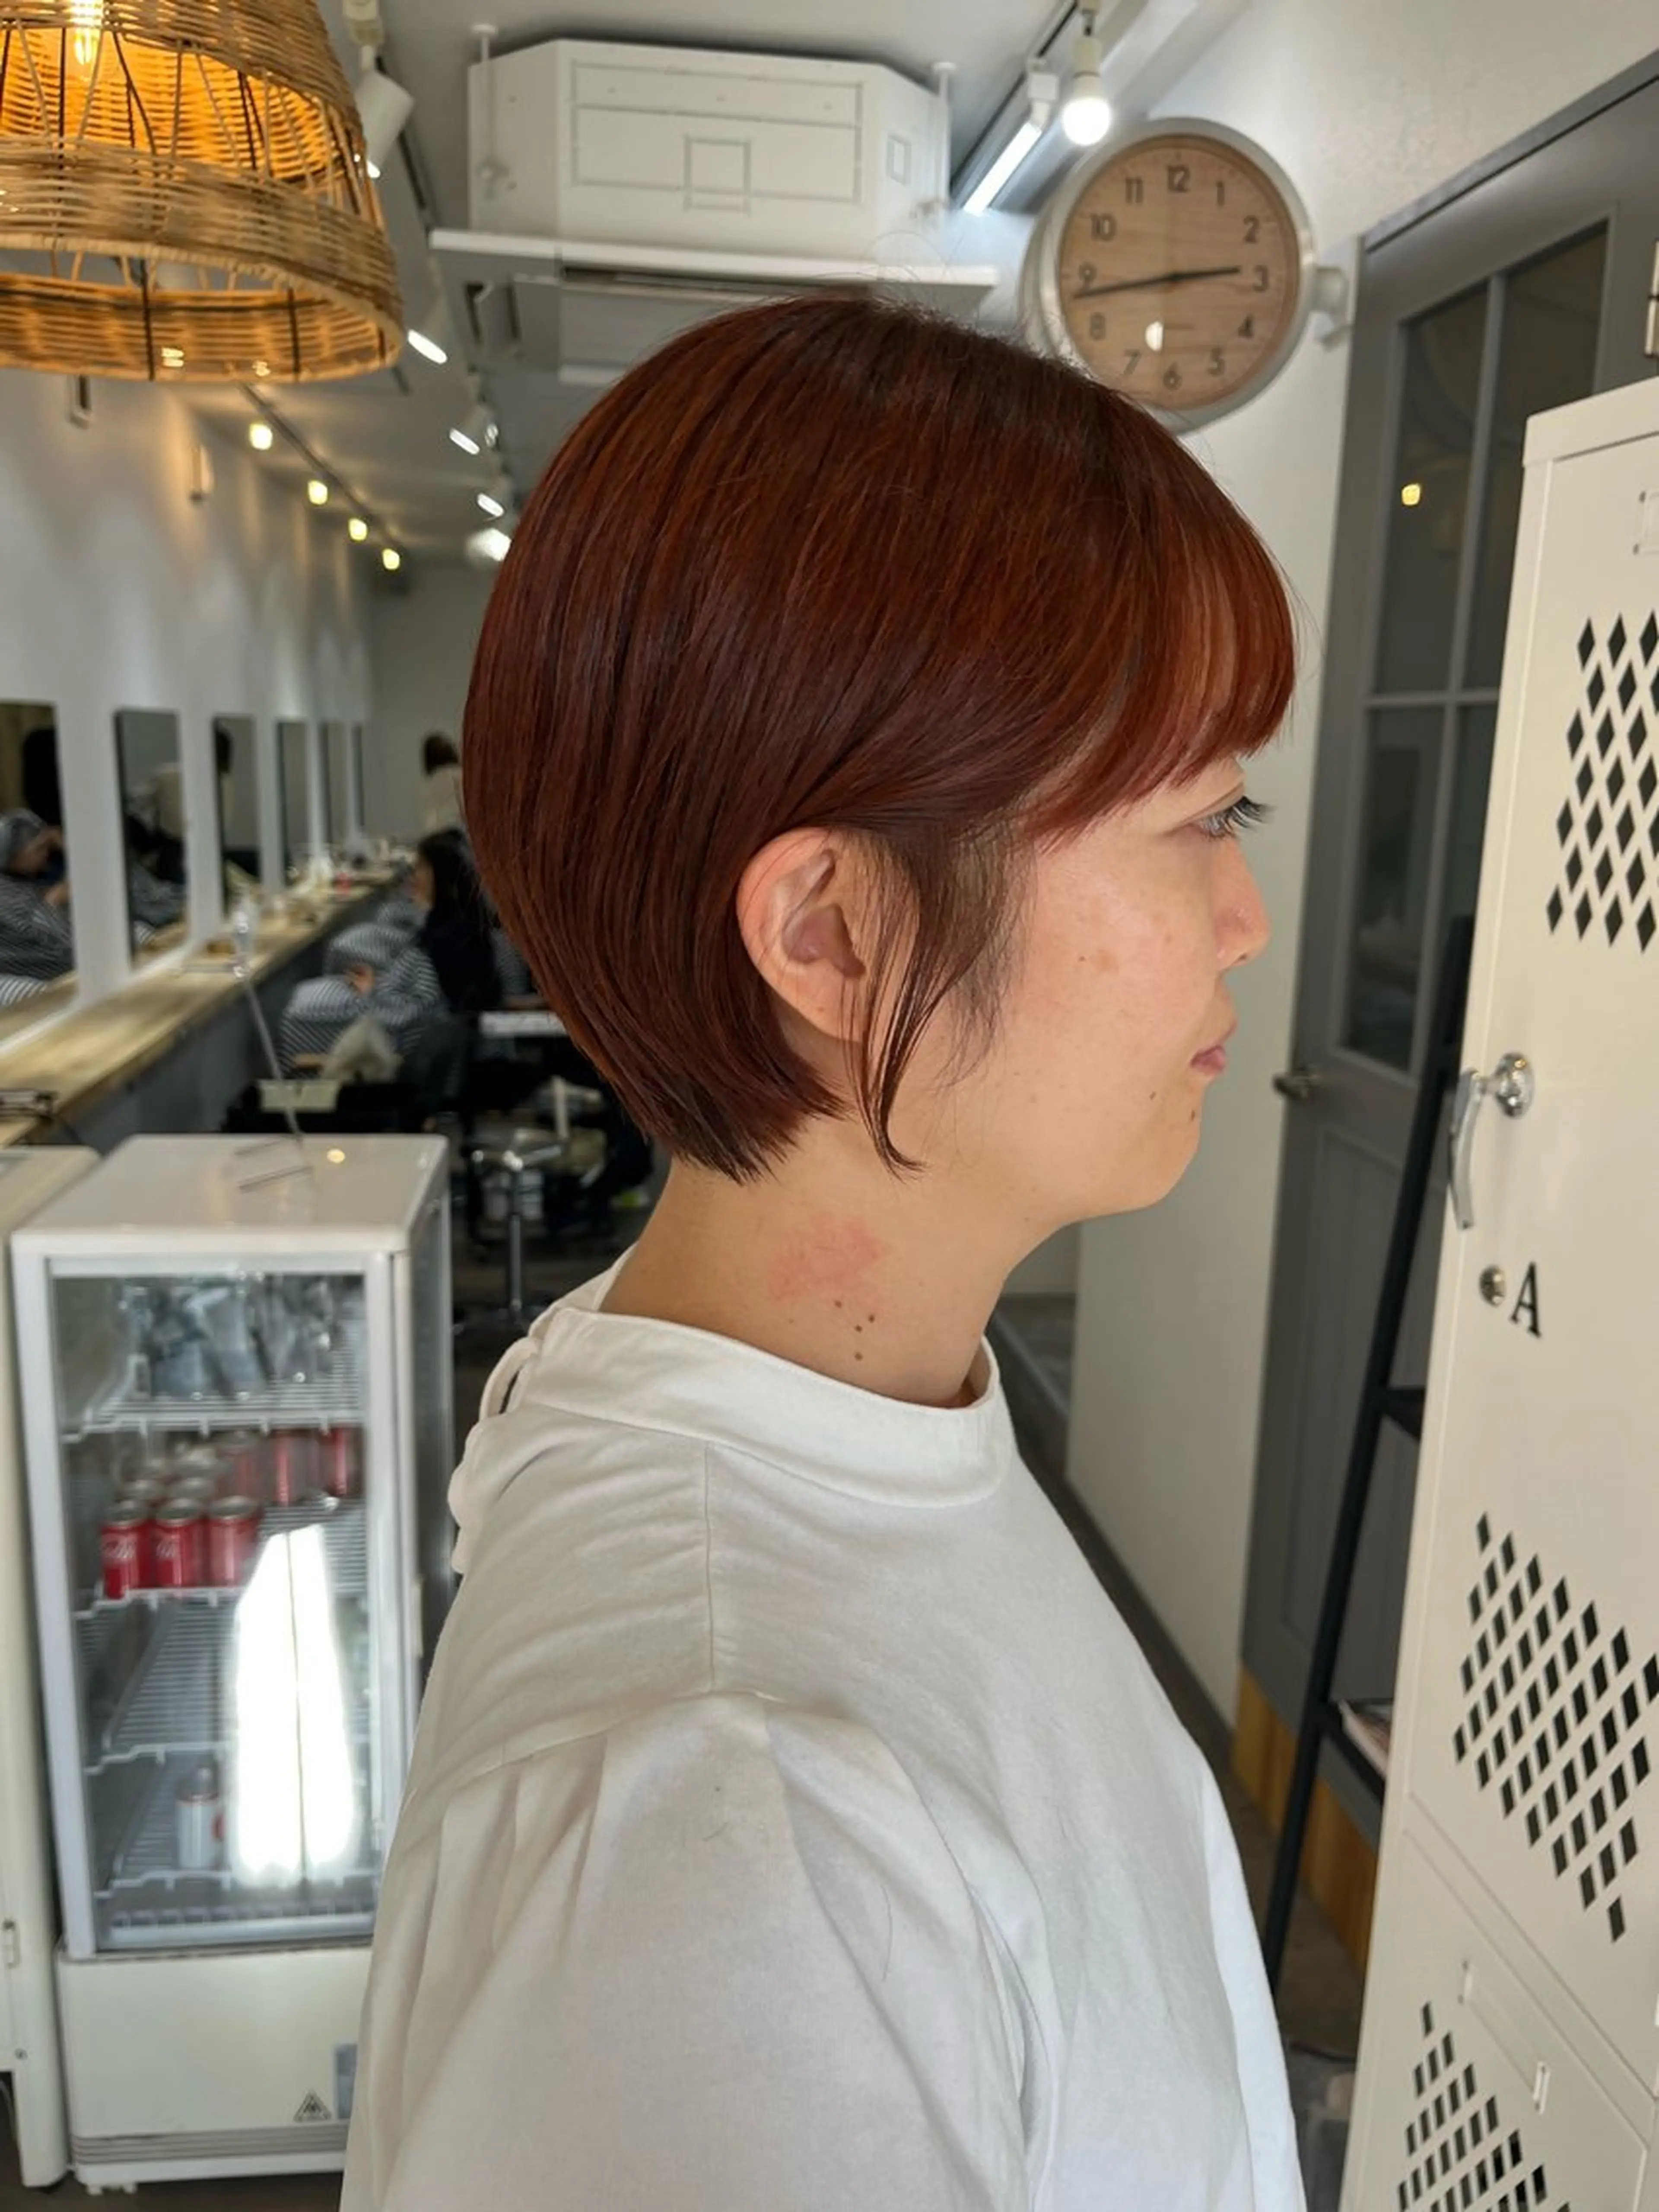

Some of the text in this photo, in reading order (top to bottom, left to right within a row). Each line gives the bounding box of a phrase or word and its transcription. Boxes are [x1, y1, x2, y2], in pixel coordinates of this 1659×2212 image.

[1125, 177, 1143, 204] 11
[1167, 165, 1190, 193] 12
[1216, 181, 1226, 207] 1
[1090, 213, 1117, 241] 10
[1244, 216, 1259, 243] 2
[1078, 262, 1096, 289] 9
[1255, 265, 1268, 292] 3
[1089, 312, 1106, 340] 8
[1237, 315, 1254, 337] 4
[1122, 350, 1141, 375] 7
[1208, 347, 1225, 375] 5
[1162, 362, 1182, 389] 6
[1509, 1262, 1541, 1339] A
